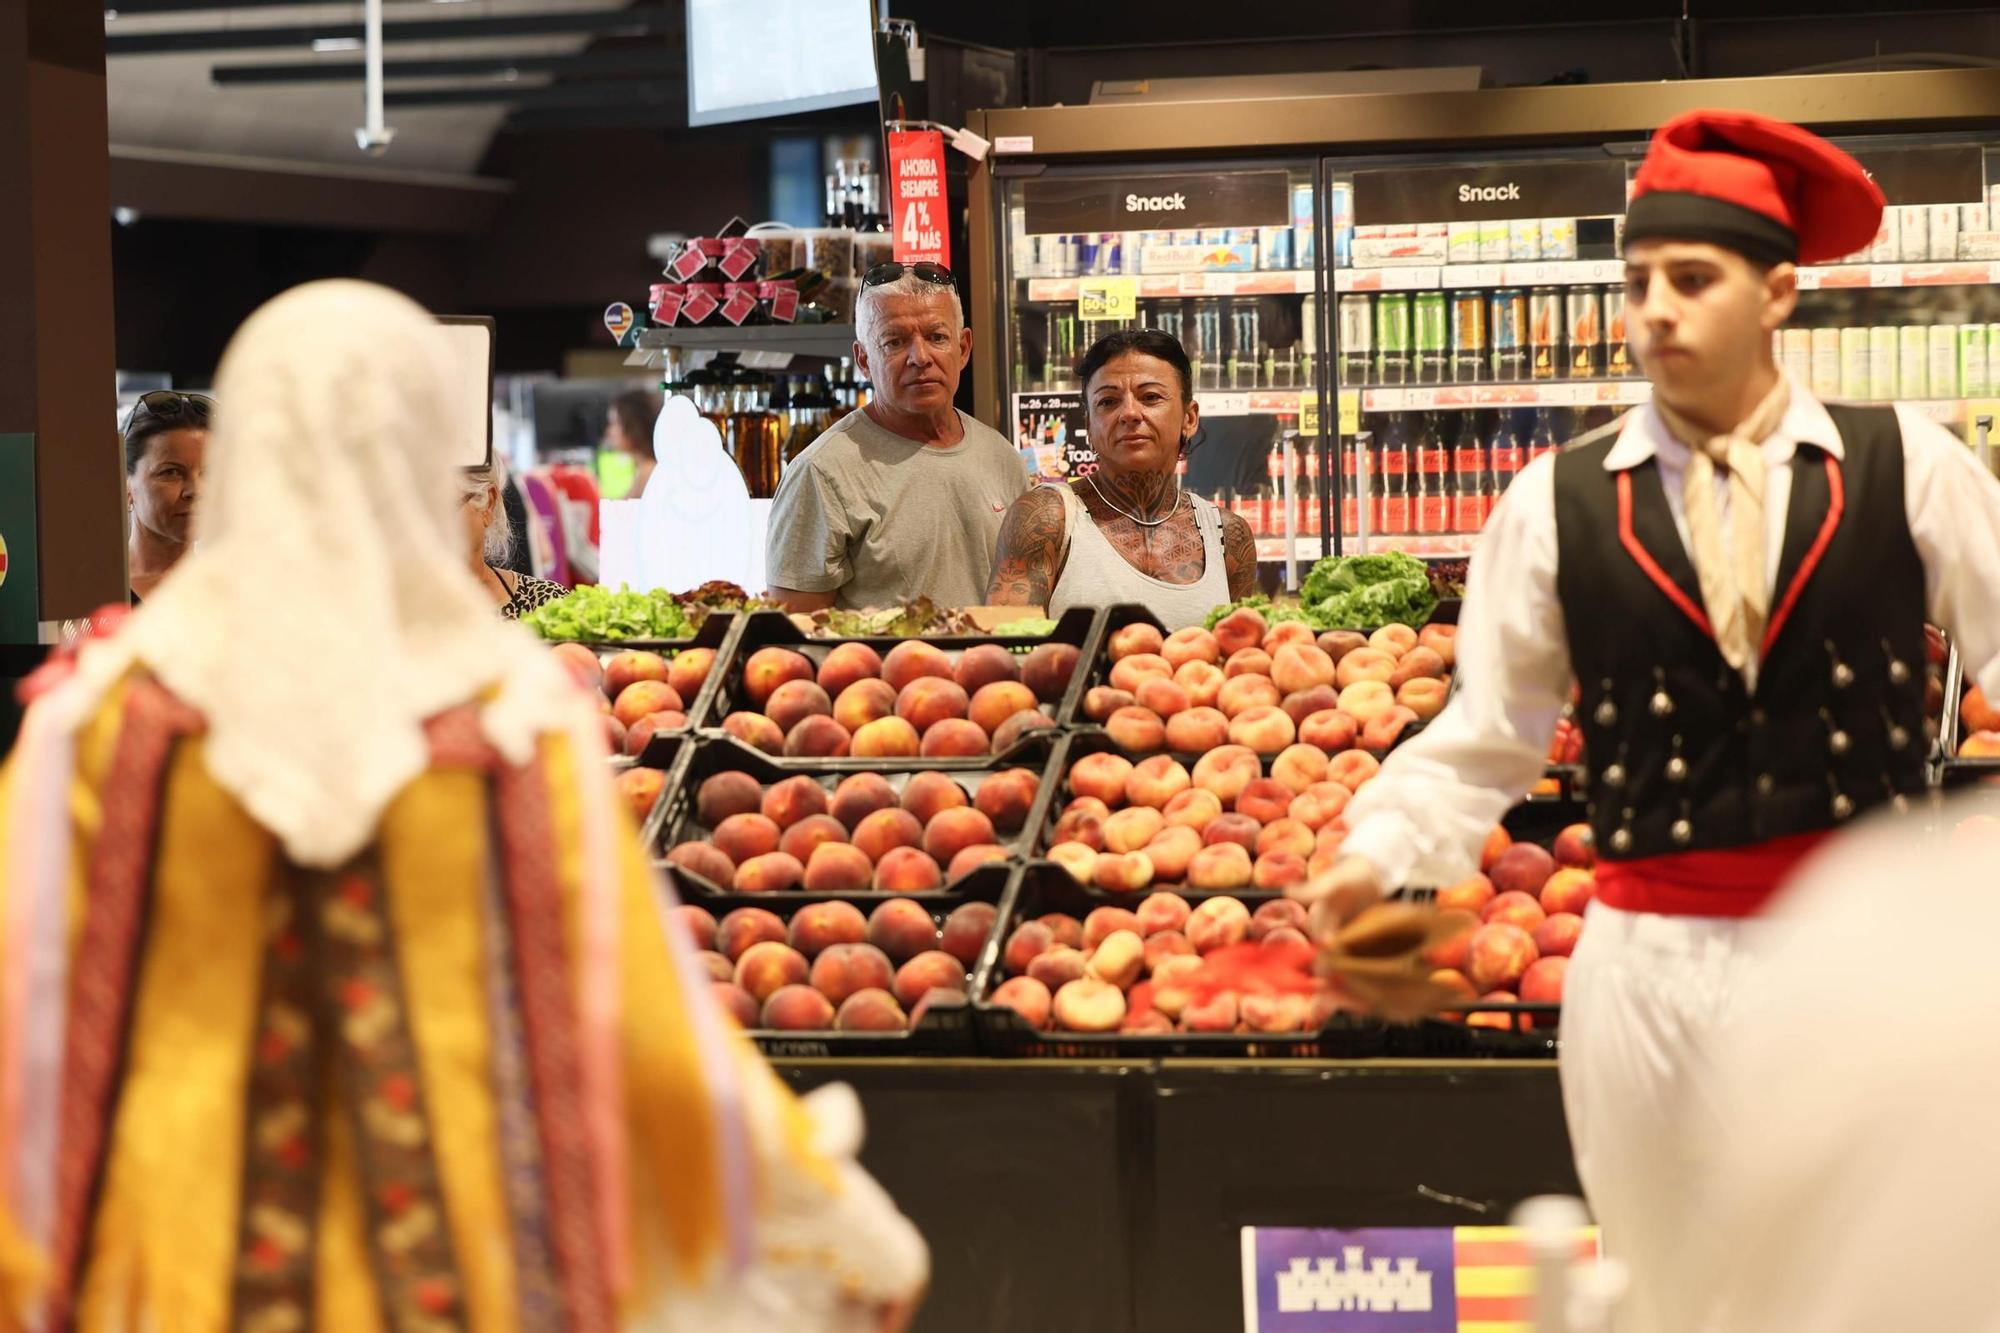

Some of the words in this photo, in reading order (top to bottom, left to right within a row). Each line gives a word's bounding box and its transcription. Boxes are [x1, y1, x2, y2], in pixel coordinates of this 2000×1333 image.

[899, 159, 938, 177] AHORRA
[900, 179, 939, 198] SIEMPRE
[1458, 182, 1520, 203] Snack
[1125, 192, 1186, 213] Snack
[919, 227, 942, 250] MÁS
[1029, 398, 1041, 409] 26
[1048, 398, 1061, 408] 28
